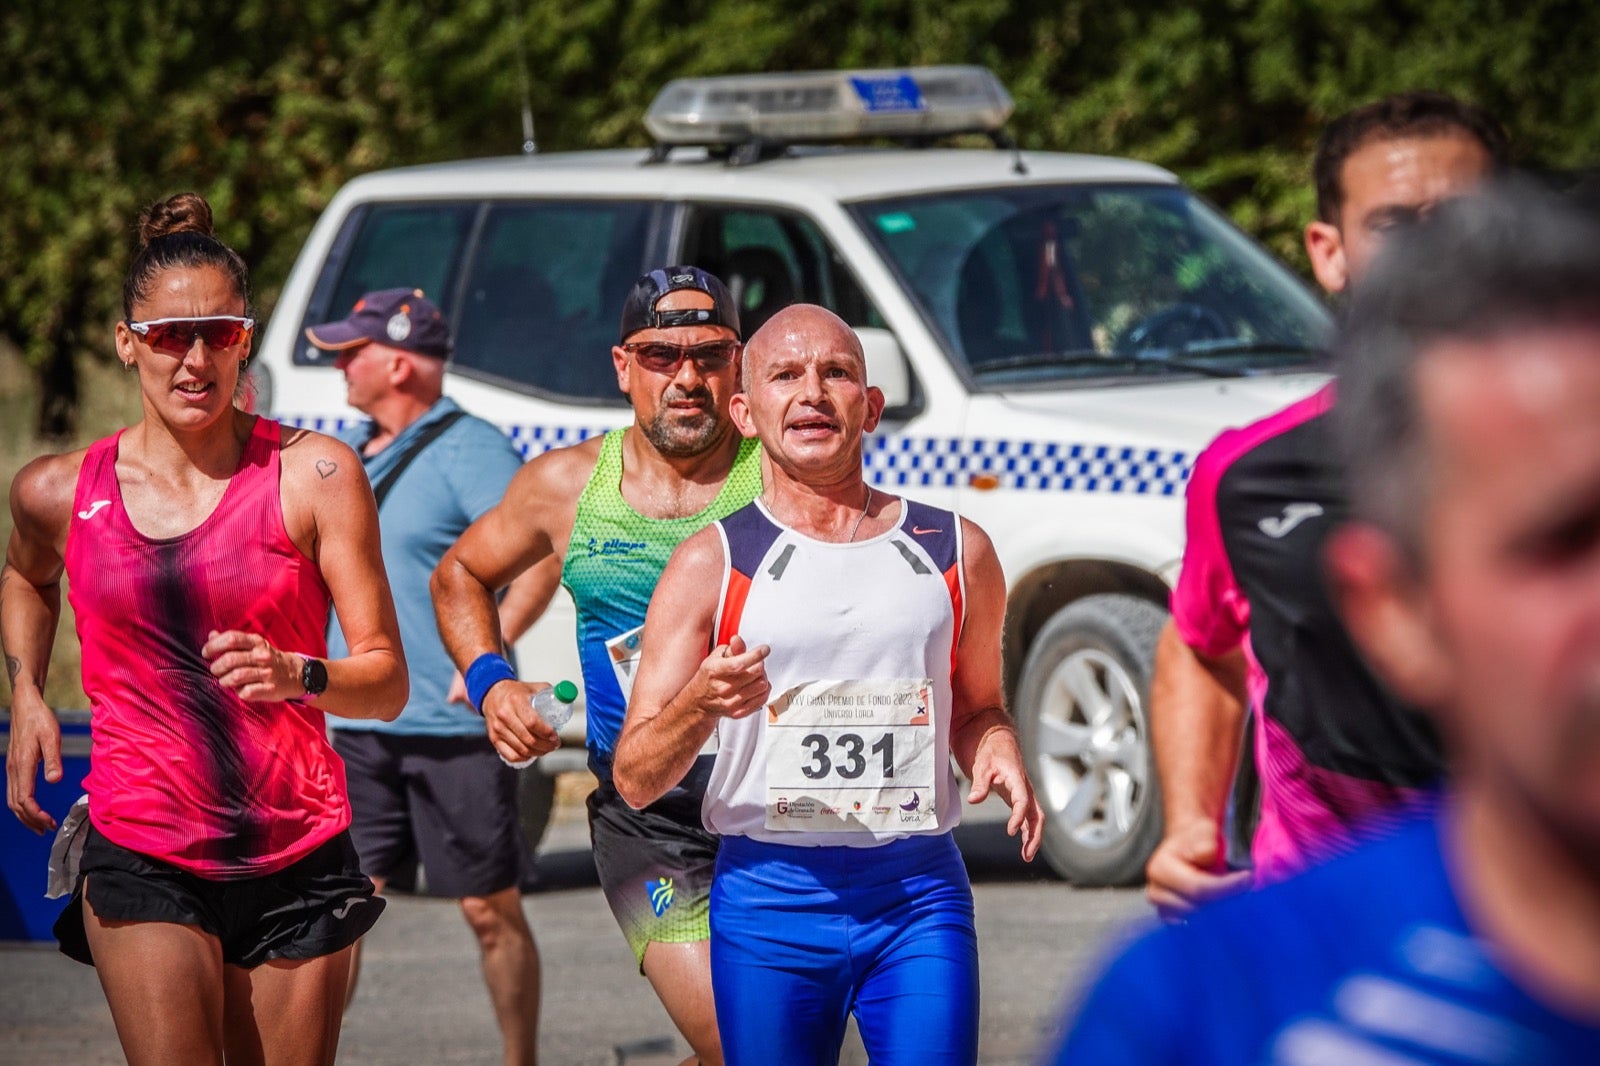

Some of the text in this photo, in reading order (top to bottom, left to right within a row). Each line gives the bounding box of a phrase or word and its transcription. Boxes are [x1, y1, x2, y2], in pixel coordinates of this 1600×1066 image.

[868, 693, 892, 706] FONDO
[855, 708, 874, 719] LORCA
[801, 732, 894, 779] 331
